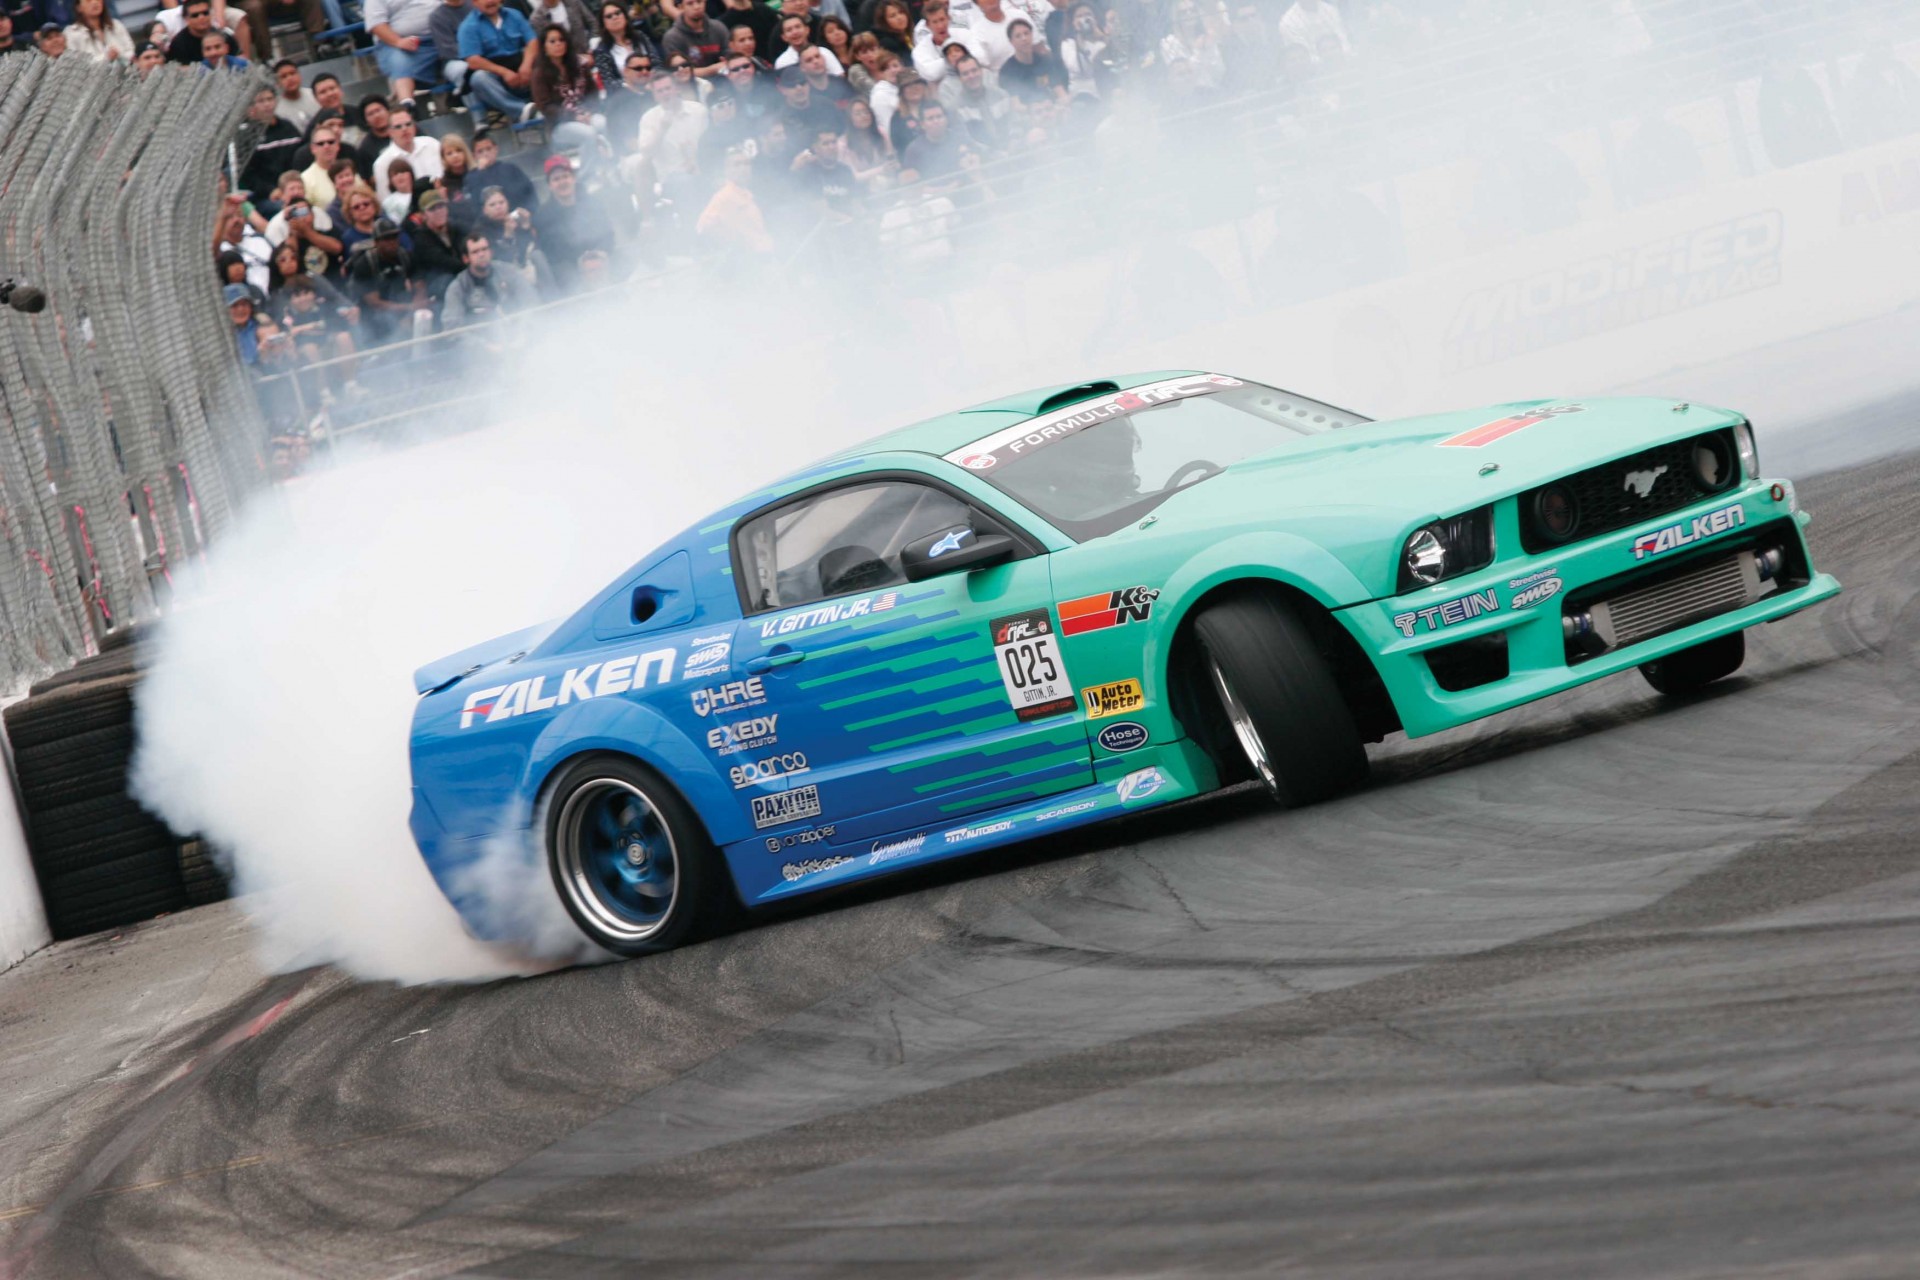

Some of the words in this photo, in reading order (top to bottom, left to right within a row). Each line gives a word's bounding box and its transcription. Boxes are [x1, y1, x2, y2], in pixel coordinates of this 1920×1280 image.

[1009, 403, 1126, 453] FORMULA
[1631, 502, 1746, 559] FALKEN
[1509, 568, 1557, 588] Streetwise
[761, 618, 776, 638] V.
[778, 604, 844, 634] GITTIN
[841, 598, 871, 619] JR.
[1417, 588, 1500, 630] TEIN
[1004, 639, 1058, 689] 025
[459, 647, 678, 730] FALKEN
[708, 676, 765, 708] HRE
[1023, 687, 1047, 703] GITTIN,
[1101, 683, 1132, 700] Auto
[1101, 694, 1141, 712] Meter
[707, 713, 778, 748] EXEDY
[719, 740, 749, 757] RACING
[749, 735, 778, 750] CLUTCH
[1104, 727, 1141, 742] Hose
[1109, 736, 1143, 748] Techniques
[729, 751, 807, 784] sparco
[753, 786, 819, 820] PAXTON
